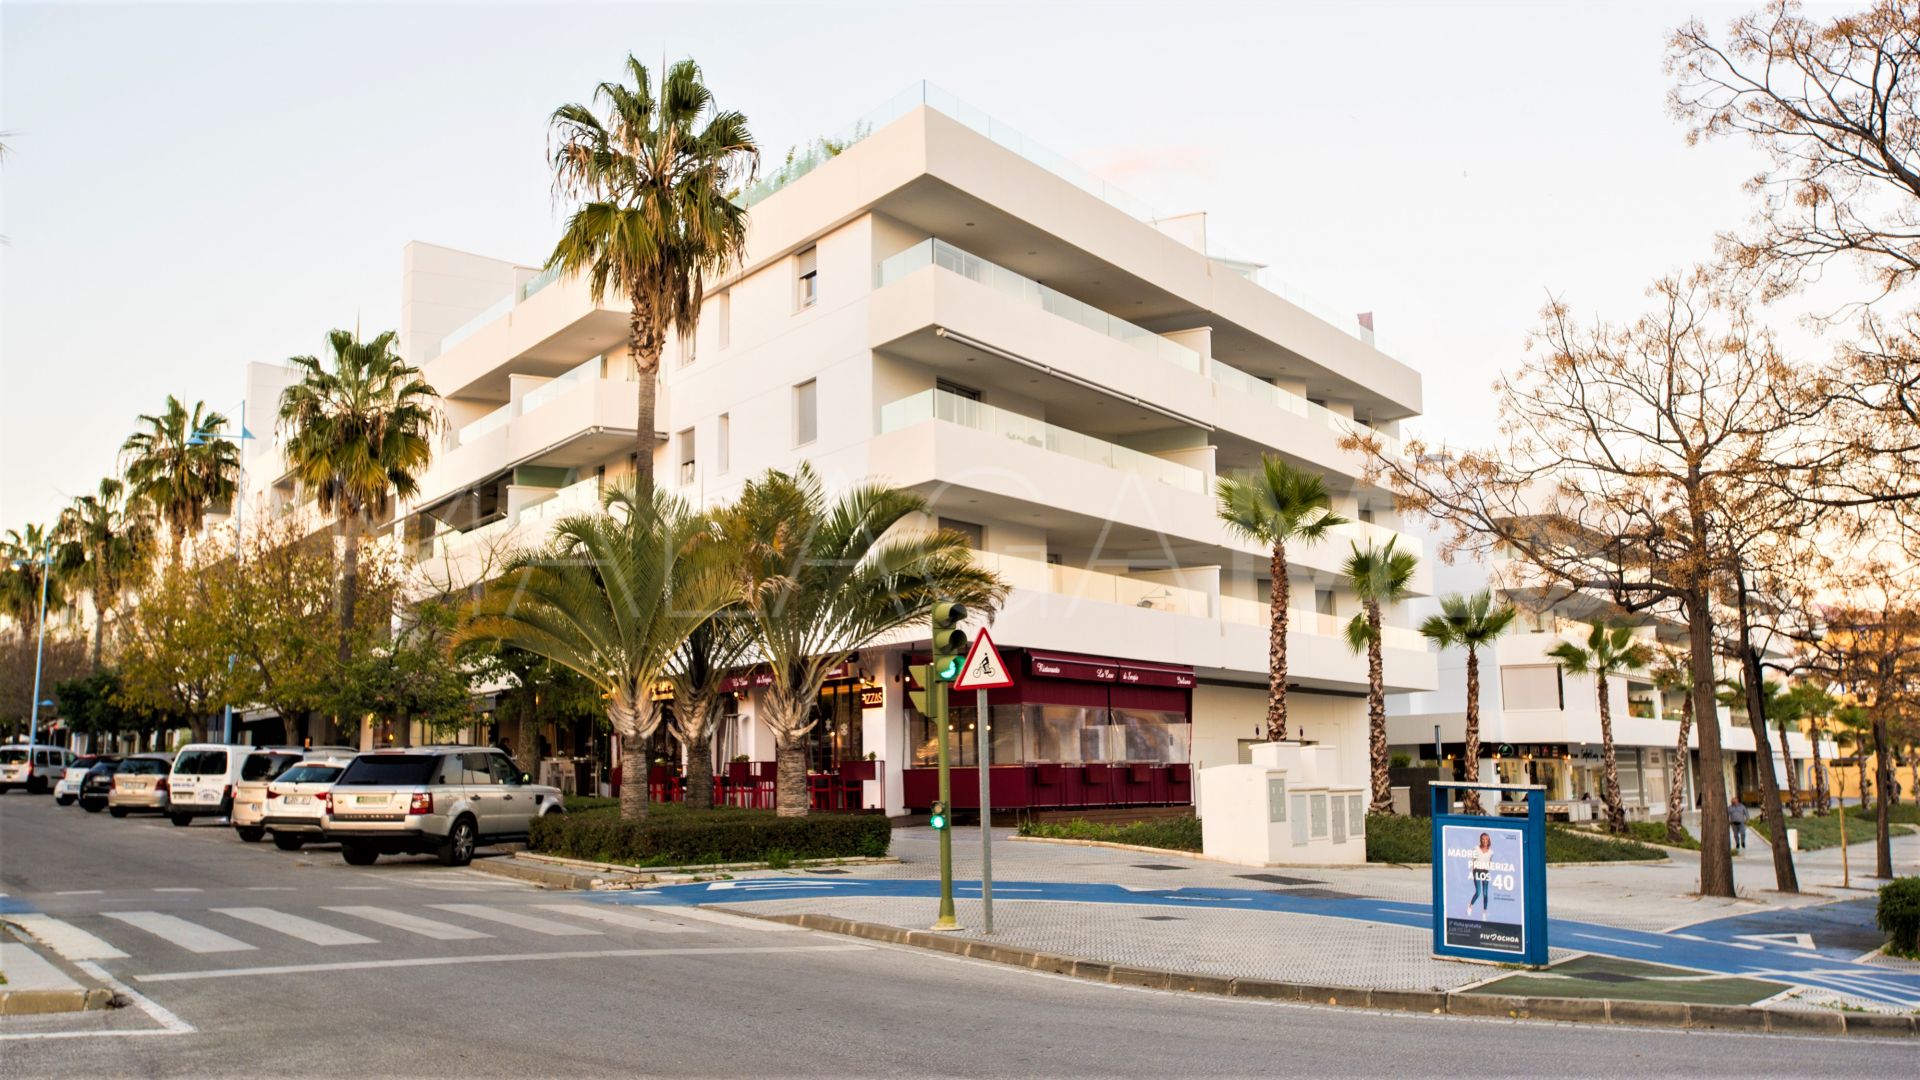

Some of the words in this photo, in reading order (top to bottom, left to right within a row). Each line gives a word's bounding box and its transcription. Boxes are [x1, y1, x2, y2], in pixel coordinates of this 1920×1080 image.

[1448, 848, 1478, 858] MADRE
[1468, 860, 1515, 872] PRIMERIZA
[1468, 872, 1475, 880] A
[1475, 872, 1491, 881] LOS
[1492, 874, 1514, 891] 40
[1497, 935, 1519, 943] OCHOA
